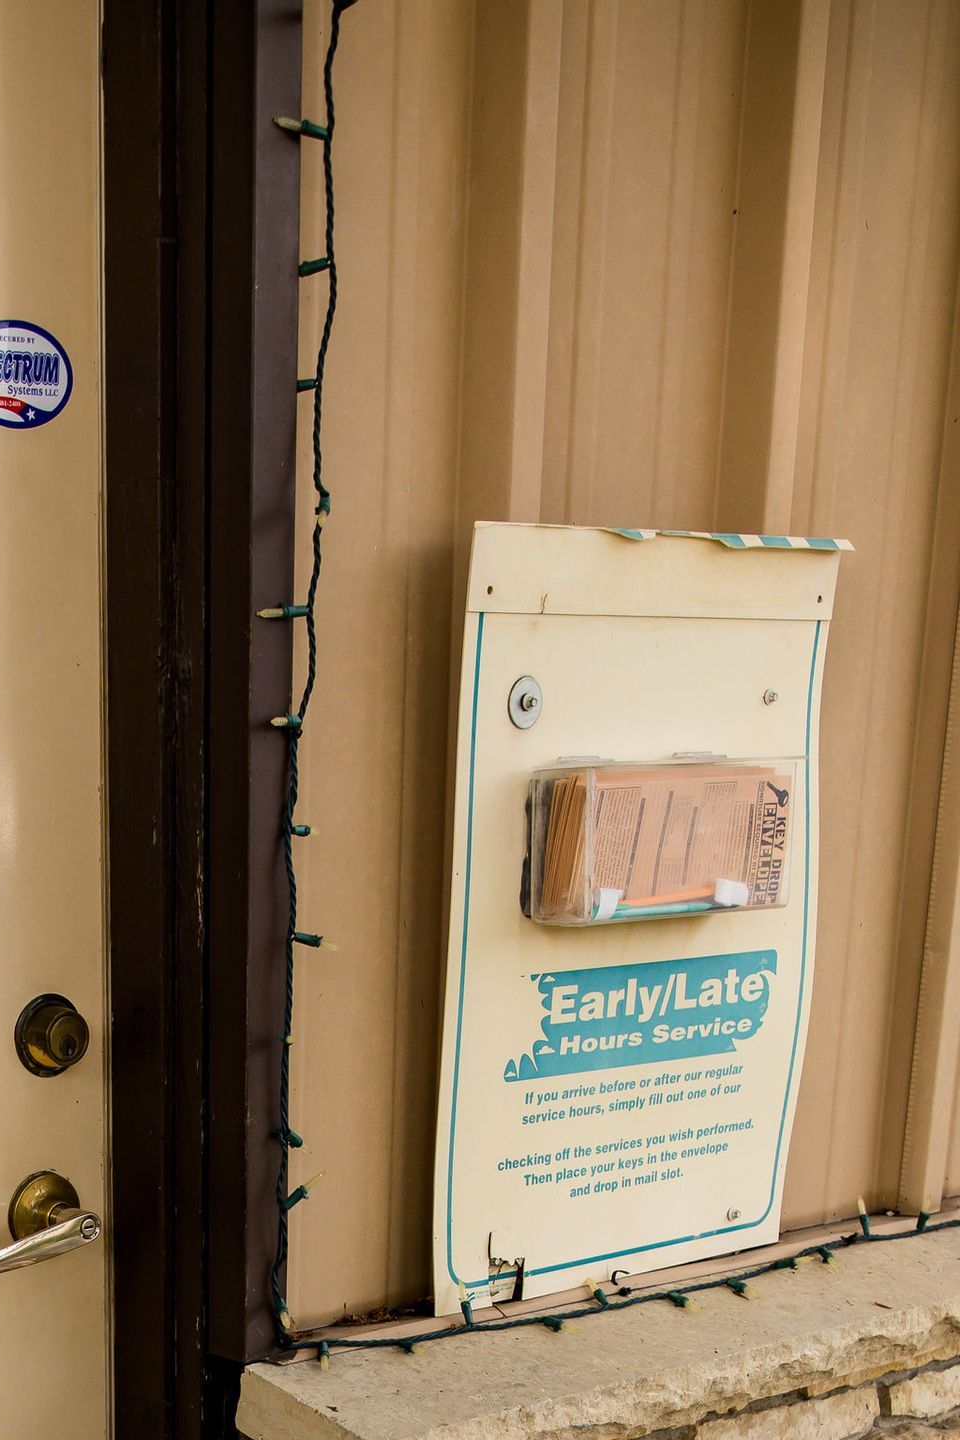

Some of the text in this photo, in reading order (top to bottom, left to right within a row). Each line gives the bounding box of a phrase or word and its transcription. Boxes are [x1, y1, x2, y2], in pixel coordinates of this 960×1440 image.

[8, 385, 58, 397] Systems LLC
[753, 802, 777, 905] ENVELOPE
[766, 816, 787, 904] KEY DROP
[550, 969, 765, 1024] Early/Late
[560, 1017, 753, 1055] Hours Service
[522, 1083, 741, 1125] service hours, simply fill out one of our
[525, 1064, 743, 1105] If you arrive before or after our regular
[497, 1118, 754, 1171] checking off the services you wish performed.
[524, 1141, 728, 1187] Then place your keys in the envelope
[570, 1167, 684, 1198] and drop in mail slot.
